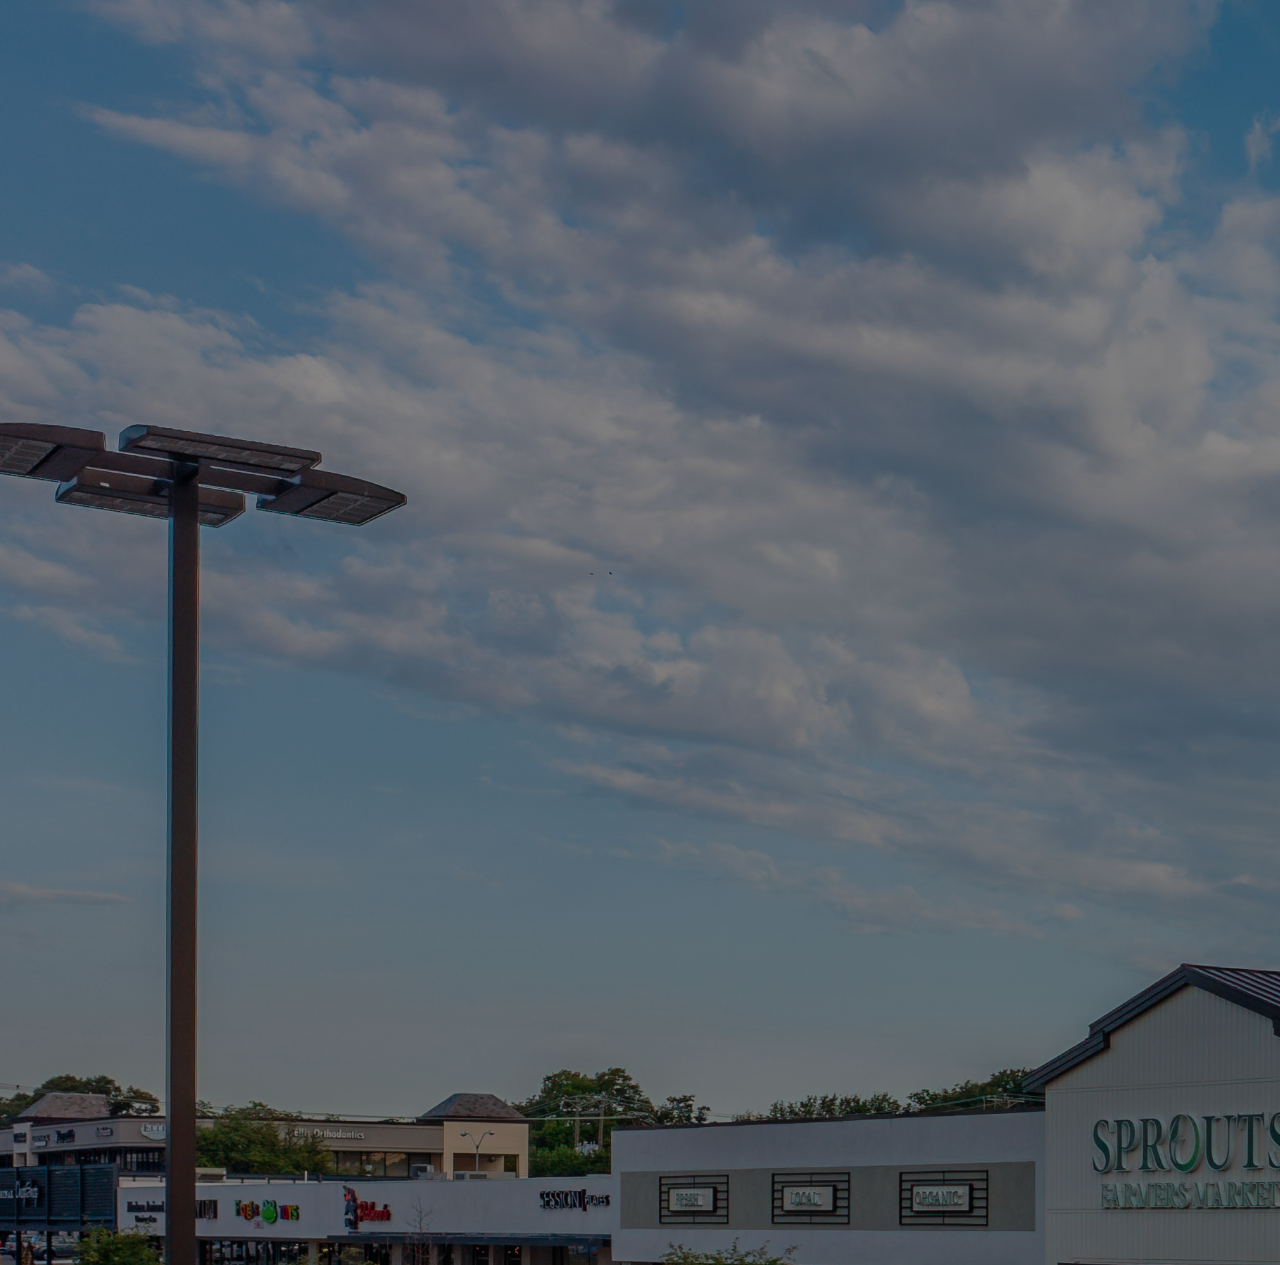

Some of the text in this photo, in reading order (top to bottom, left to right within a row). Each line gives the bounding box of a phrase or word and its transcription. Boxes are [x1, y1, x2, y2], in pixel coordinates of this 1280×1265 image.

[313, 1128, 364, 1139] Orthodontics
[540, 1190, 582, 1209] SESSION
[914, 1189, 963, 1206] ORGANIC
[1100, 1182, 1192, 1209] FARMERS
